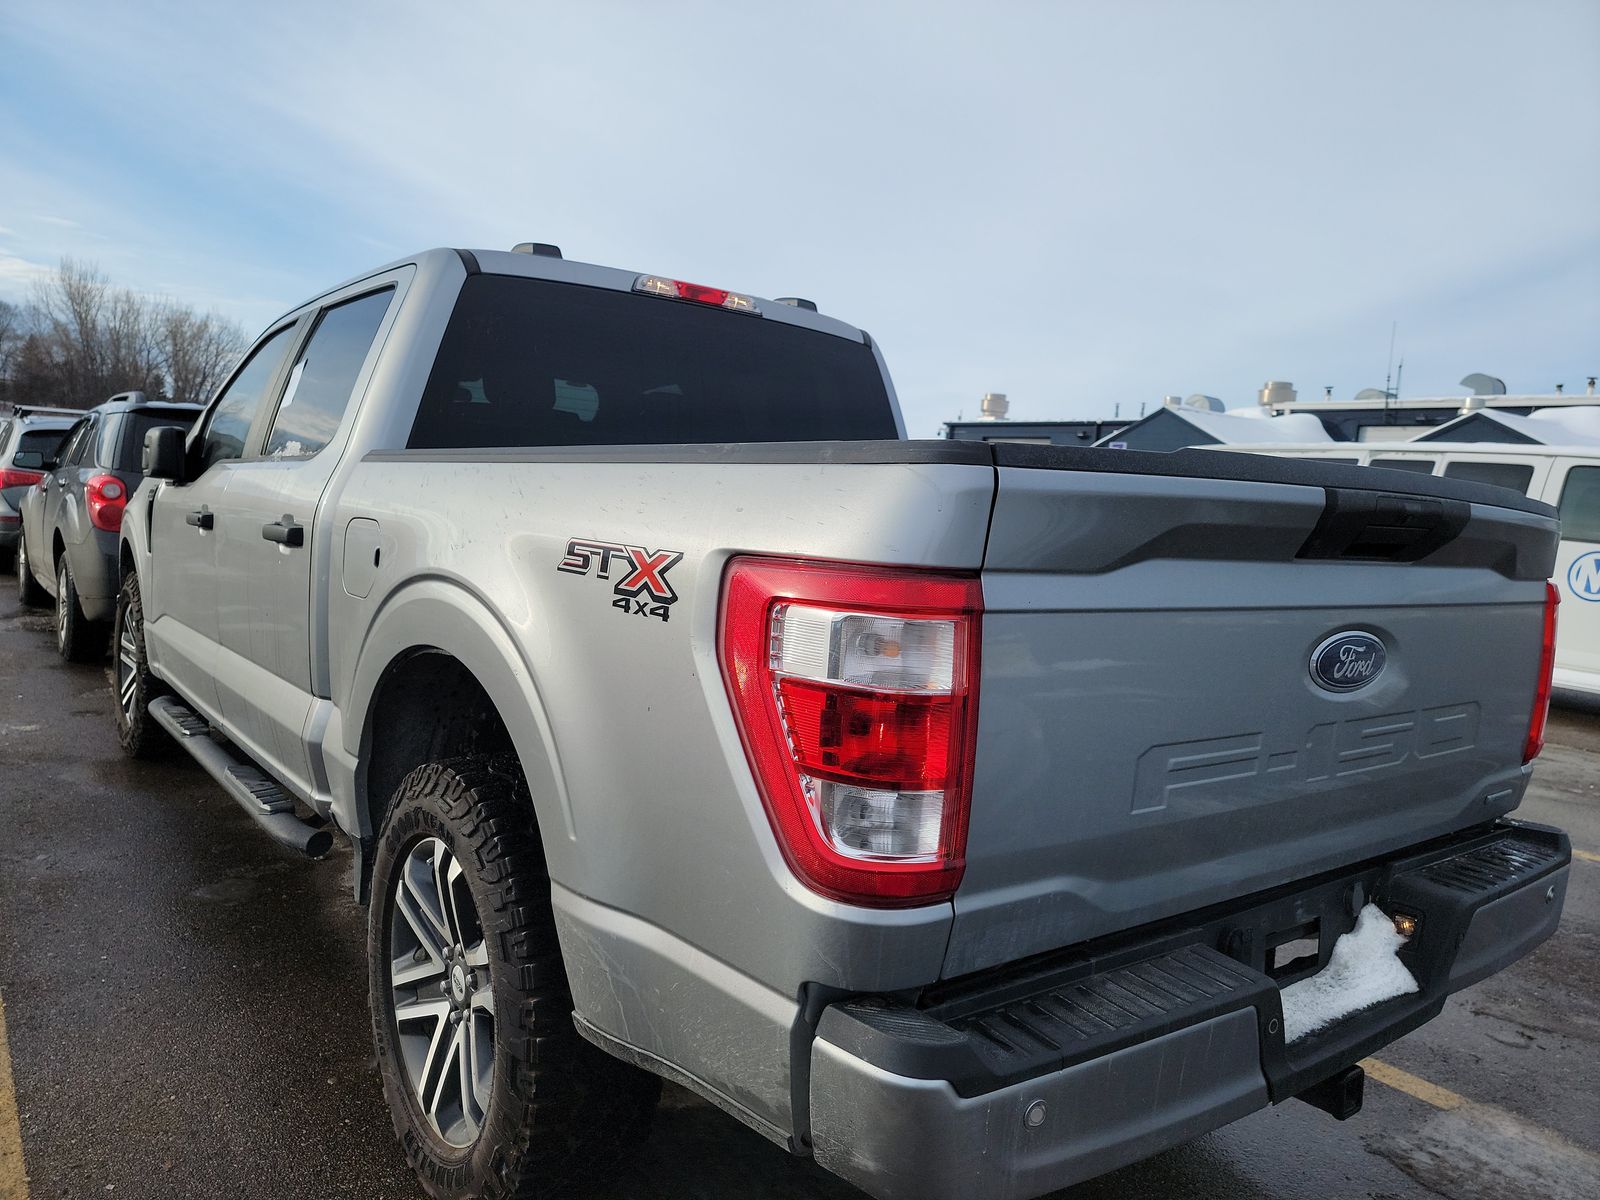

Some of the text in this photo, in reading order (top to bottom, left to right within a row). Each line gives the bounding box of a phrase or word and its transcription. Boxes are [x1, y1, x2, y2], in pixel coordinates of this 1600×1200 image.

[557, 537, 684, 605] STX
[1333, 645, 1376, 679] Ford
[1130, 700, 1481, 814] F-150
